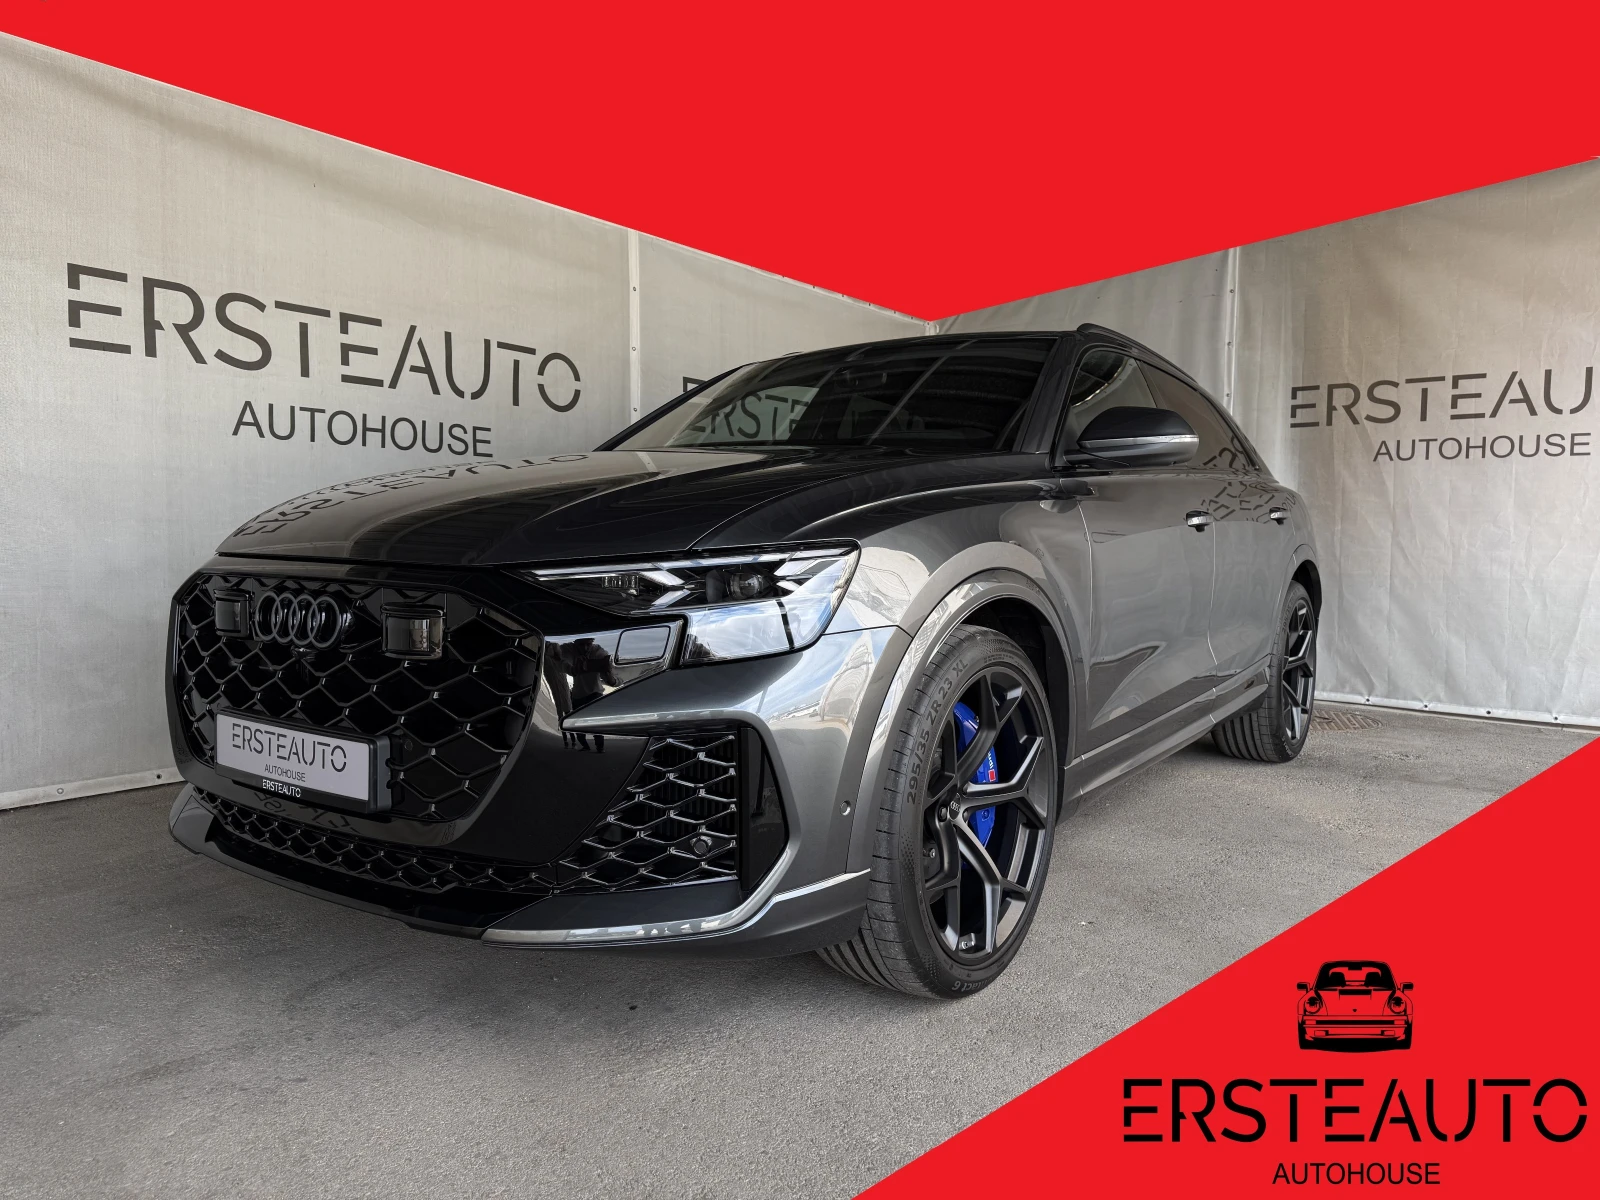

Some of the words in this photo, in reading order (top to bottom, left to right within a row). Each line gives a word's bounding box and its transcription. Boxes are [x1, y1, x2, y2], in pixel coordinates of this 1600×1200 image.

[66, 262, 582, 413] ERSTEAUTO
[1289, 366, 1594, 428] ERSTEAU
[231, 400, 494, 458] AUTOHOUSE
[1372, 432, 1592, 463] AUTOHOUSE
[232, 723, 347, 772] ERSTEAUTO
[906, 728, 930, 805] 295/35
[926, 699, 942, 726] ZR
[938, 678, 953, 701] 23
[951, 659, 969, 678] XL
[262, 779, 301, 798] ERSTEAUTO
[264, 763, 306, 783] AUTOHOUSE
